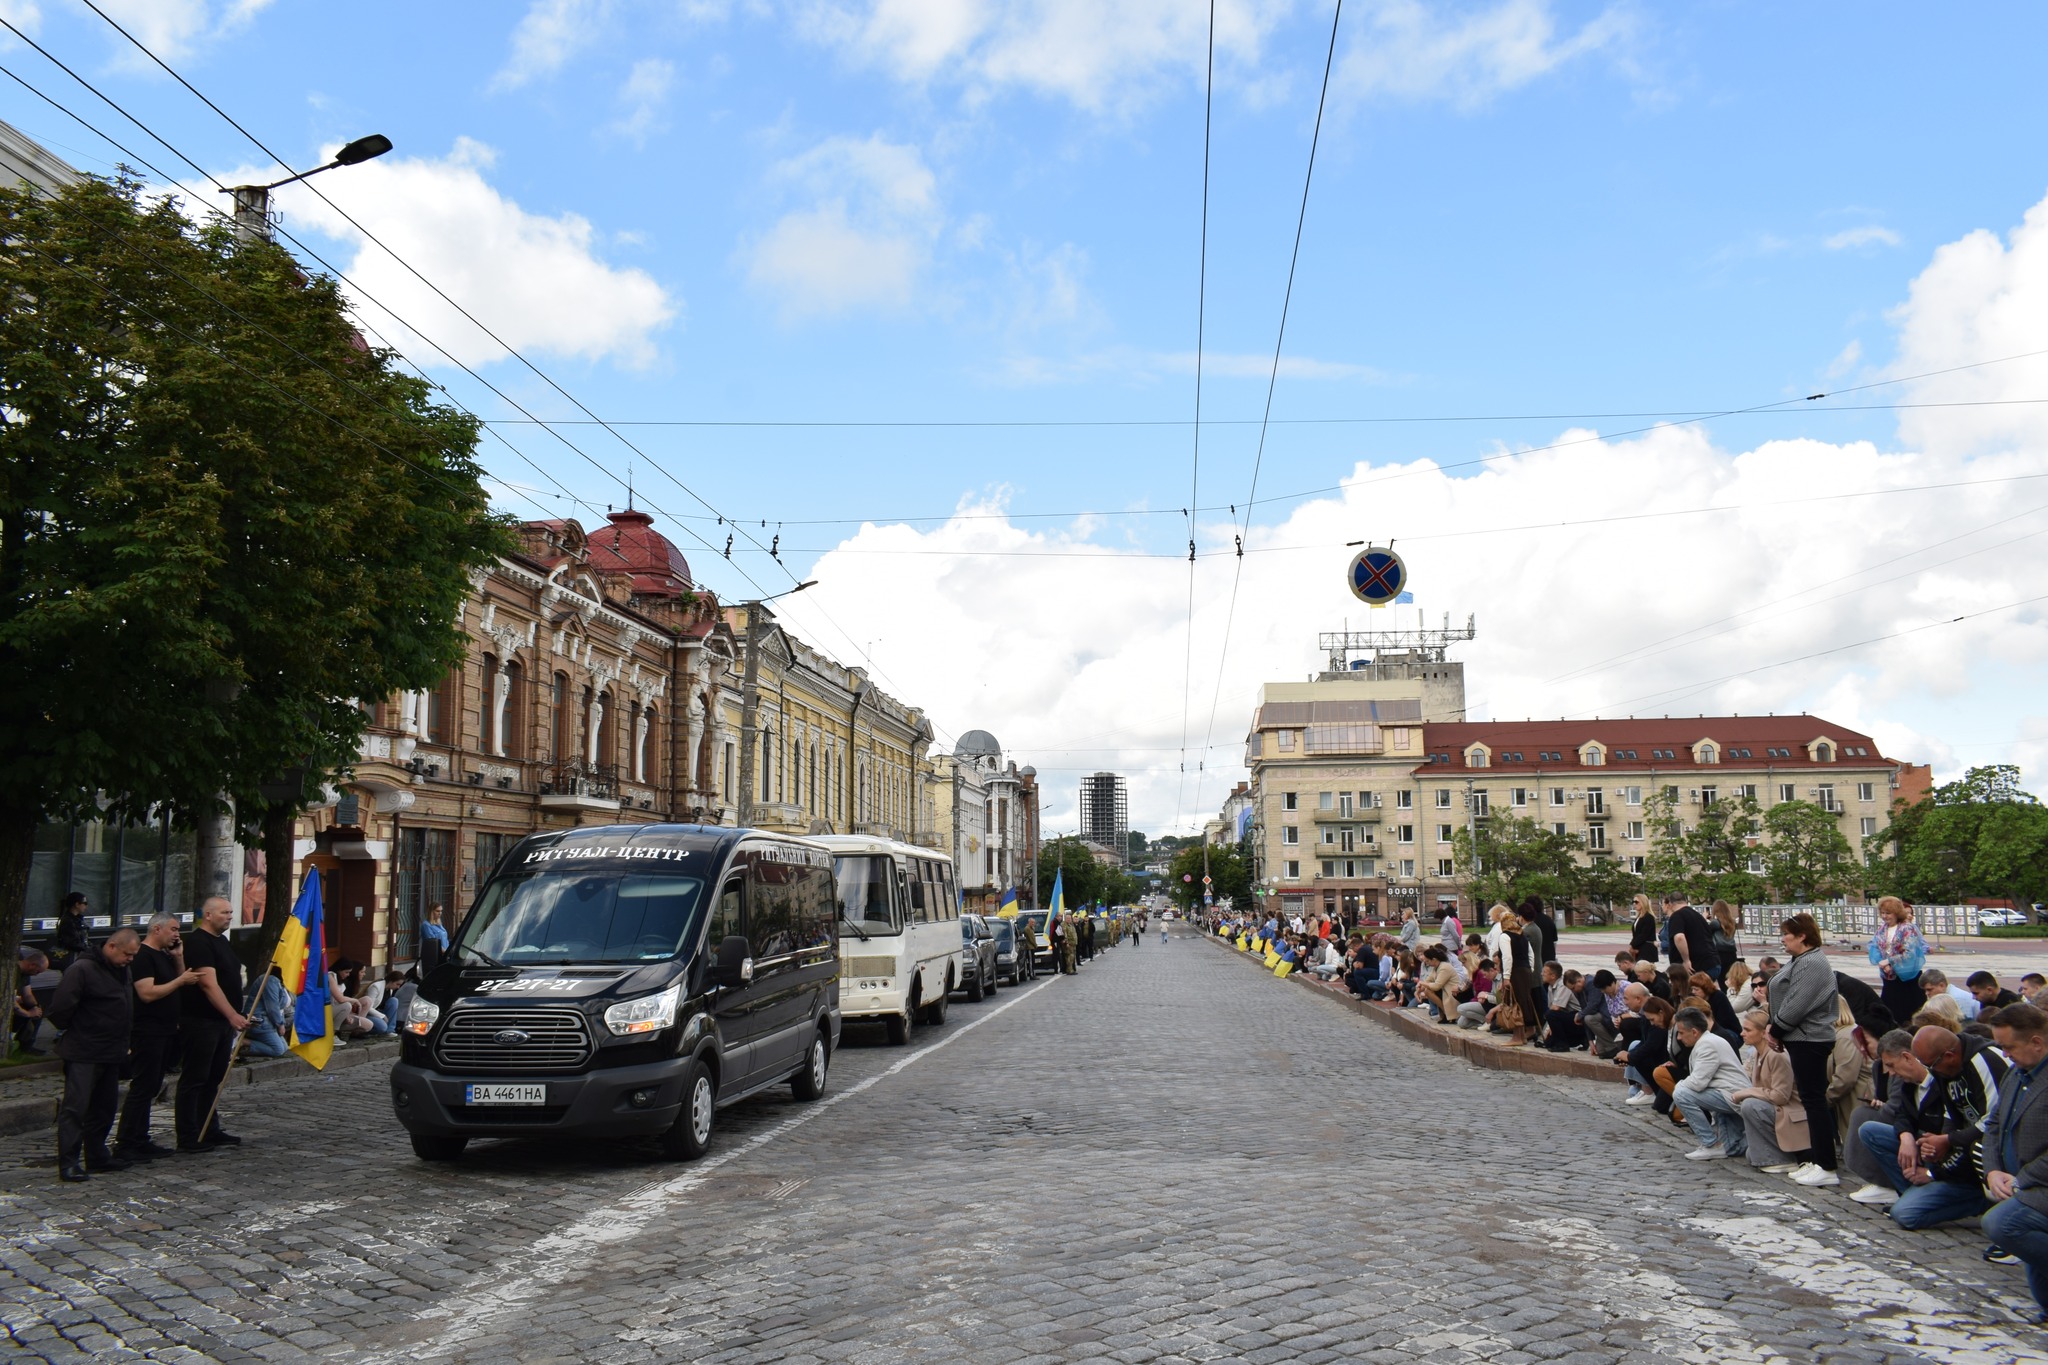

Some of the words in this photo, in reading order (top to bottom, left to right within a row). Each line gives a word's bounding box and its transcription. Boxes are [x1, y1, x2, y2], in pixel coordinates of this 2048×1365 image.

[523, 846, 690, 863] РИТУАЛ-ЦЕНТР
[1387, 887, 1421, 895] GOGOL
[474, 979, 583, 992] 27-27-27
[474, 1087, 491, 1100] BA
[494, 1087, 521, 1100] 4461
[524, 1087, 542, 1100] HA
